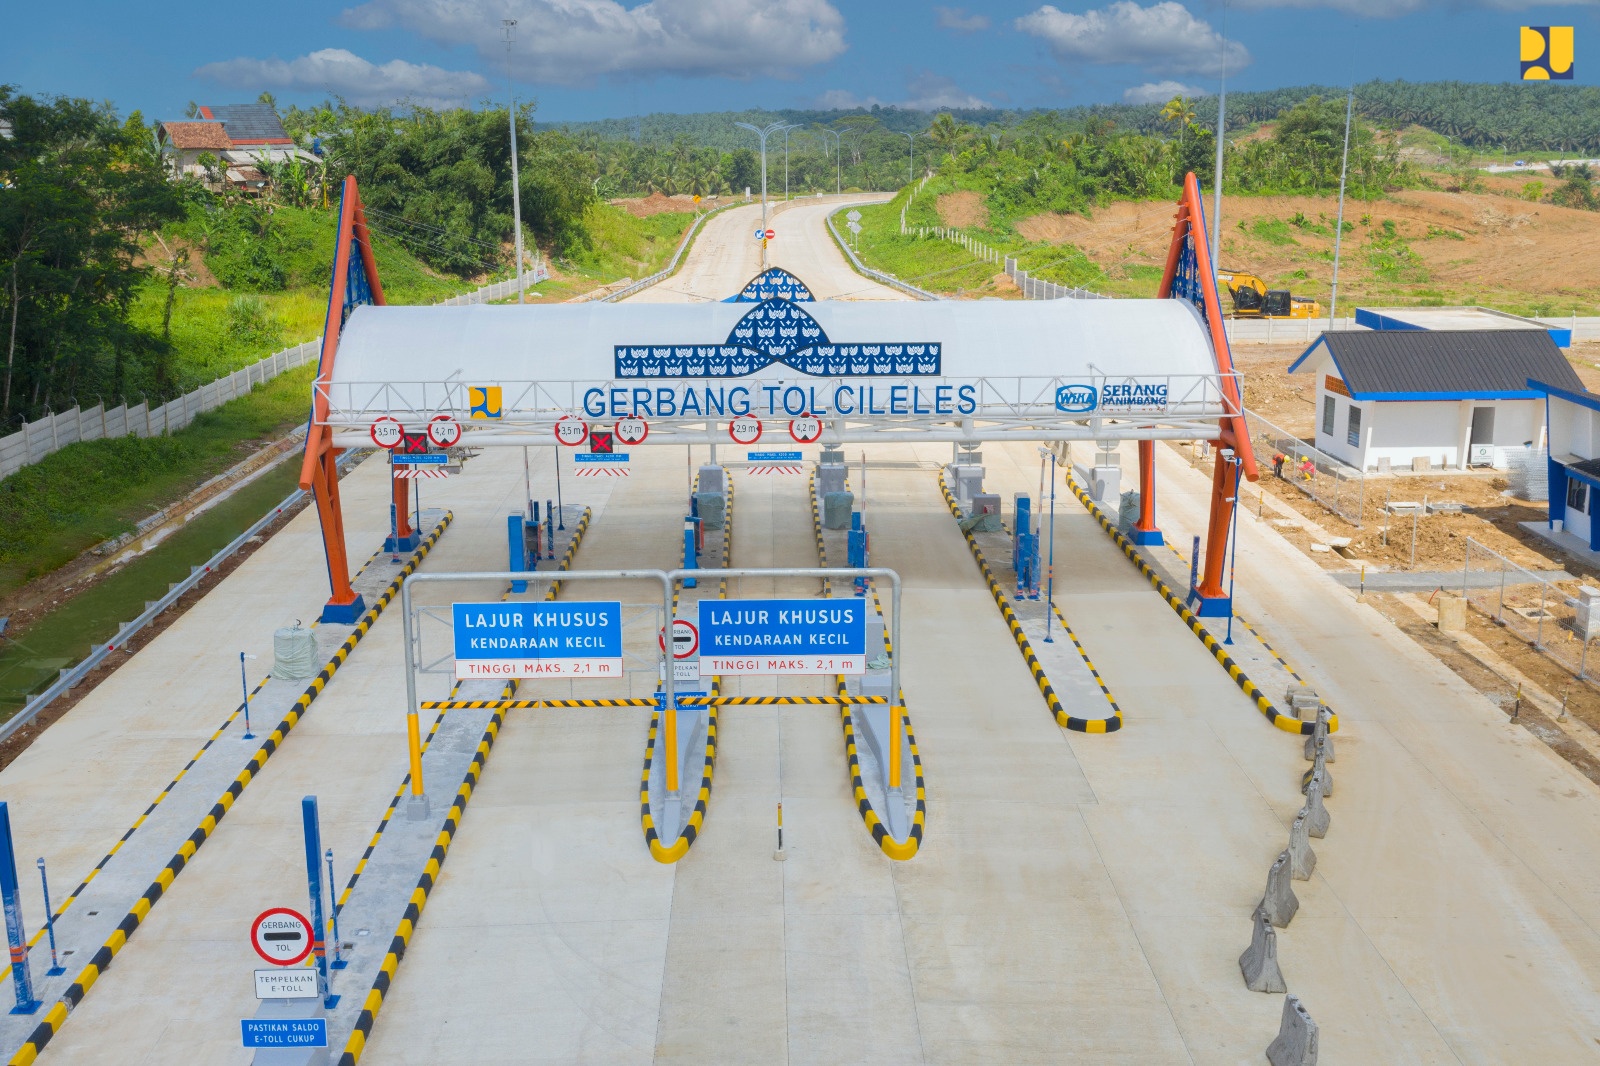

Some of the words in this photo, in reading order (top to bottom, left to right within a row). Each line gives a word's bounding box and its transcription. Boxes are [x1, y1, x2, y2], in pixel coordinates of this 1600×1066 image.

[1102, 384, 1167, 396] SERANG
[583, 386, 750, 417] GERBANG
[762, 386, 826, 416] TOL
[834, 385, 977, 415] CILELES
[1102, 396, 1167, 406] PANIMBANG
[377, 428, 388, 436] 3,5
[435, 427, 446, 436] 4,2
[561, 428, 572, 436] 3,5
[622, 425, 632, 434] 4,2
[736, 425, 746, 433] 2,9
[796, 424, 806, 432] 4,2
[809, 424, 816, 432] m
[465, 613, 523, 628] LAJUR
[533, 612, 609, 627] KHUSUS
[711, 610, 769, 625] LAJUR
[779, 610, 854, 624] KHUSUS
[470, 637, 558, 649] KENDARAAN
[565, 636, 606, 648] KECIL
[715, 634, 802, 646] KENDARAAN
[809, 634, 850, 645] KECIL
[469, 664, 516, 673] TINGGI
[524, 664, 565, 673] MAKS.
[573, 663, 590, 673] 2,1
[599, 664, 610, 672] m
[713, 660, 759, 670] TINGGI
[768, 660, 808, 669] MAKS.
[816, 660, 833, 670] 2,1
[248, 1024, 288, 1032] PASTIKAN
